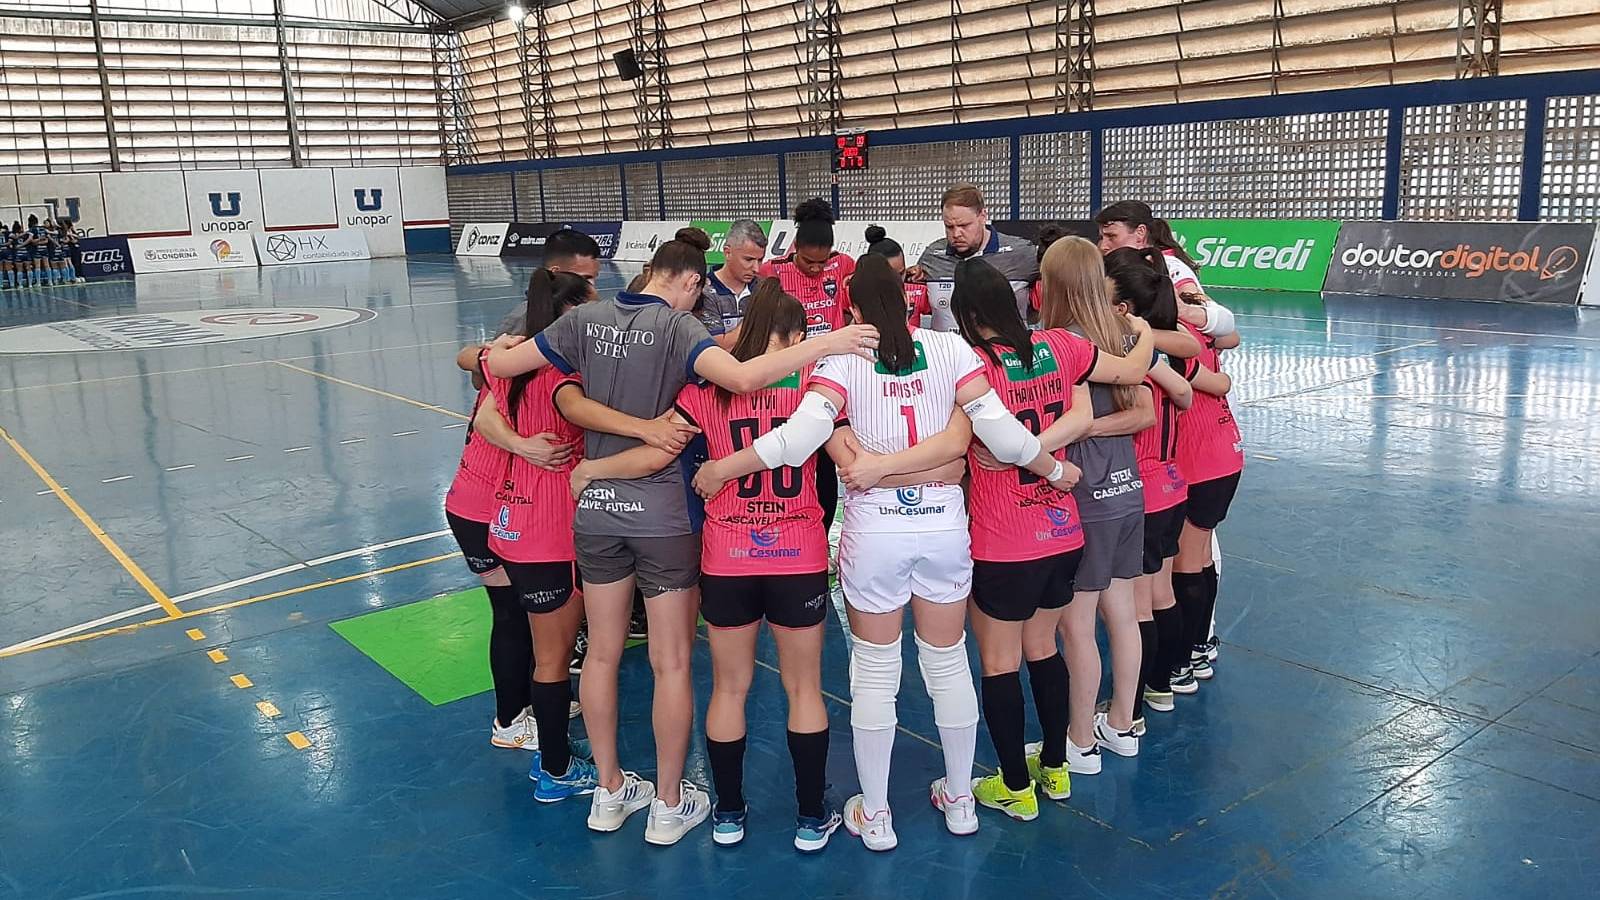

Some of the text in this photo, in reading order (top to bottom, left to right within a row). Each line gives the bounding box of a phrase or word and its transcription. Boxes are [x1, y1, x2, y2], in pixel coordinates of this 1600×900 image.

[201, 220, 253, 233] unopar
[346, 215, 392, 227] unopar
[298, 235, 328, 250] HX
[648, 234, 658, 252] 4
[157, 252, 199, 260] LONDRINA
[1195, 237, 1316, 271] Sicredi
[1385, 268, 1457, 278] IMPRESSÕES
[751, 394, 777, 411] VIVI
[901, 405, 918, 448] 1
[606, 502, 645, 512] FUTSAL
[747, 501, 786, 514] STEIN
[879, 505, 946, 516] UniCesumar
[730, 547, 801, 559] UniCesumar
